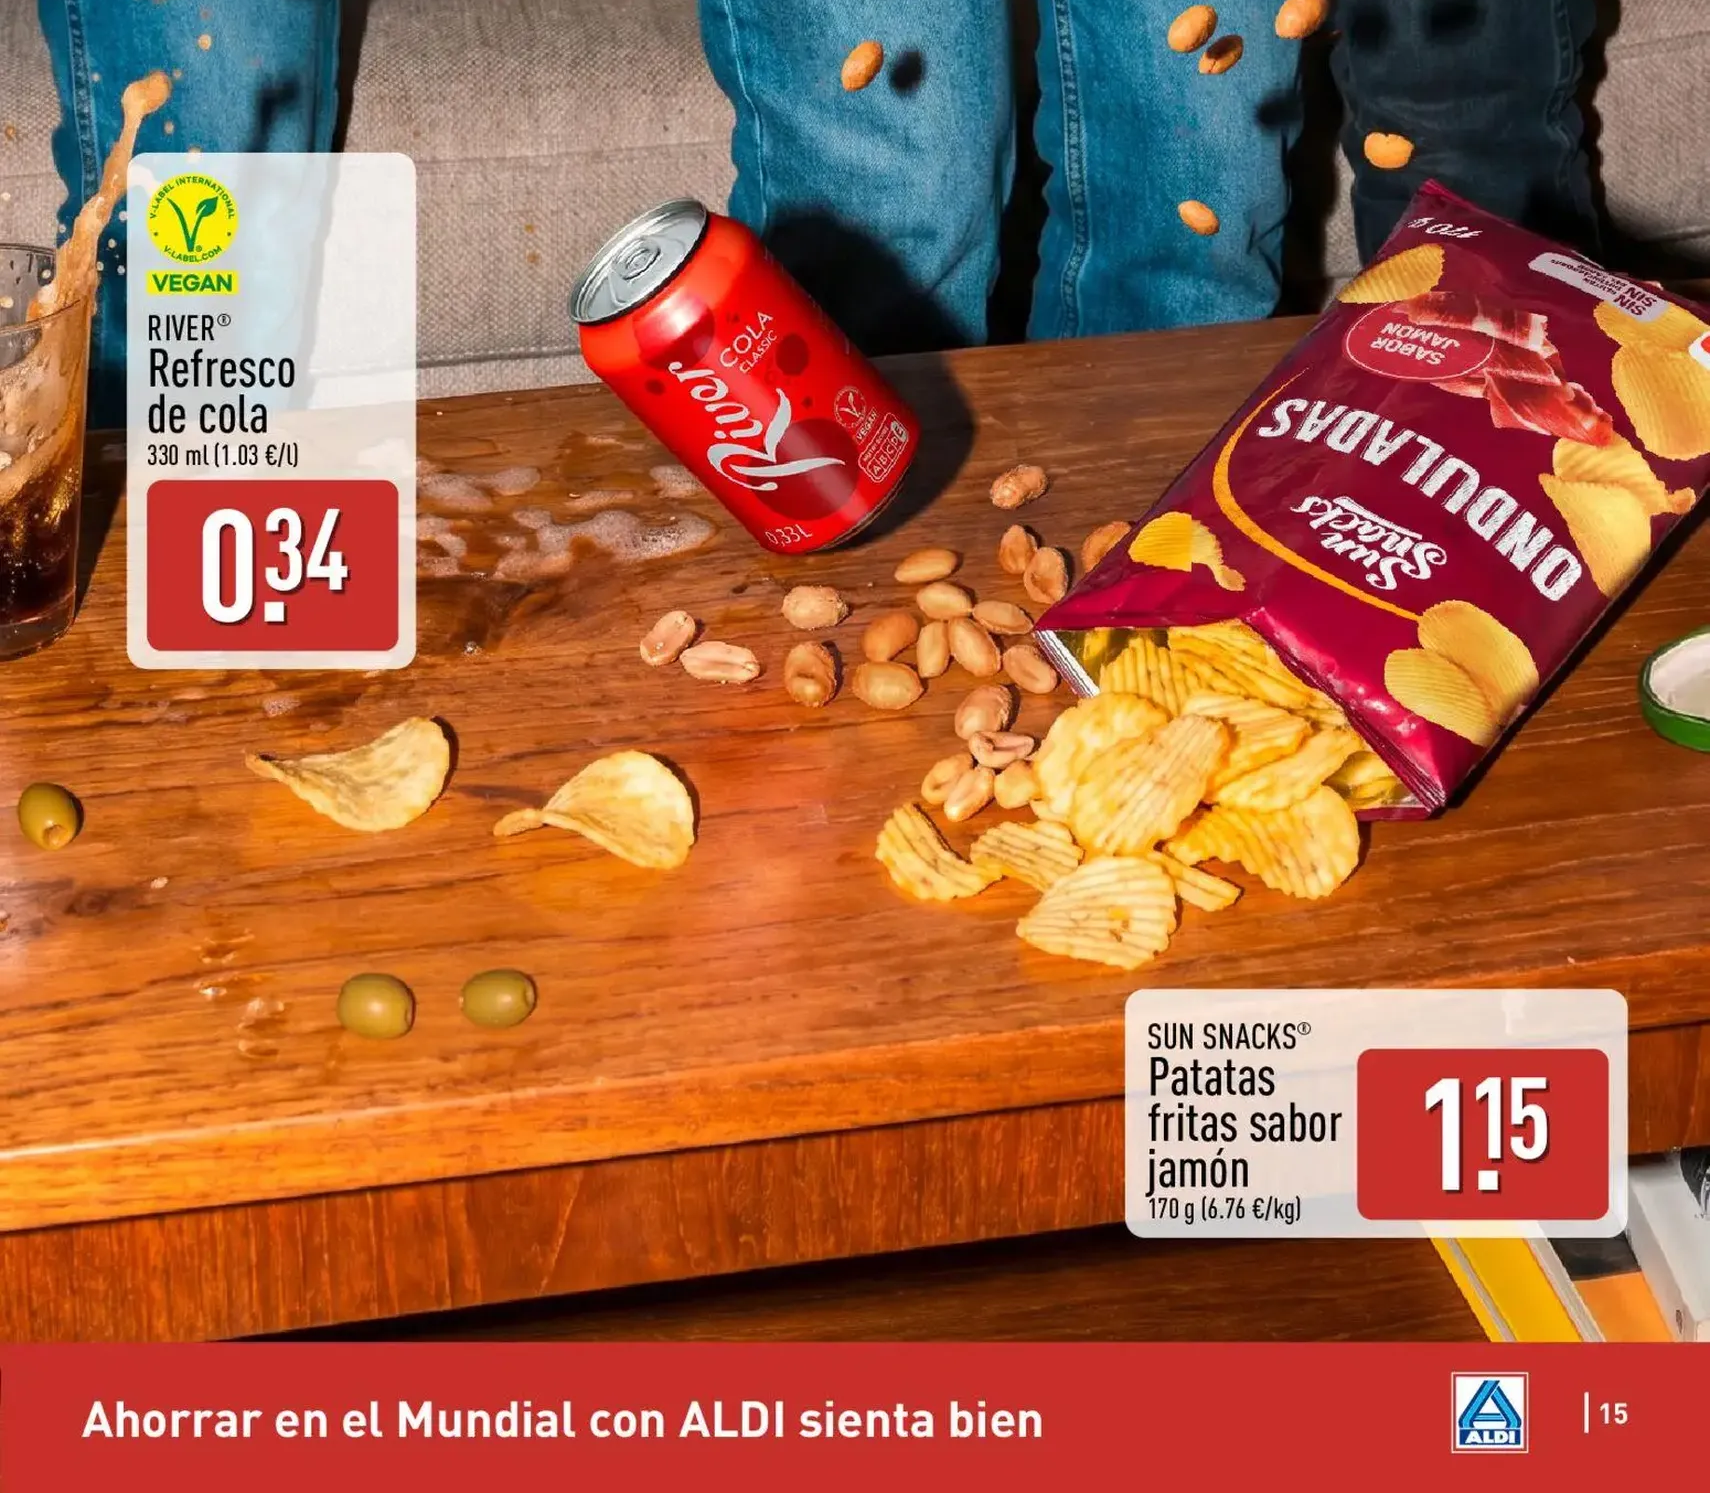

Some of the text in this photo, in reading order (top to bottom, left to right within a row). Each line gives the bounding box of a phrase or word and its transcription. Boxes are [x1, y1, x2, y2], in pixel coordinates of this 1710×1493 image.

[150, 176, 235, 219] V-LABEL INTERNATIONAL
[163, 245, 222, 263] V-LABEL.COM
[152, 274, 232, 292] VEGAN
[1624, 287, 1657, 307] SIN
[1613, 295, 1647, 316] SIN
[719, 311, 773, 369] COLA
[740, 330, 777, 373] CLASSIC
[1370, 336, 1446, 365] SABOR
[150, 349, 294, 388] Refresco
[149, 394, 267, 433] de cola
[668, 361, 846, 492] River
[148, 445, 178, 465] 330
[187, 445, 209, 465] ml
[215, 443, 258, 467] (1.03
[1257, 396, 1585, 603] ONDULADAS
[1290, 496, 1447, 580] Snacks
[1320, 532, 1406, 590] Sun
[1149, 1023, 1193, 1049] SUN
[1151, 1057, 1274, 1096] Patatas
[1148, 1102, 1342, 1142] fritas sabor
[1146, 1148, 1248, 1198] jamón
[1149, 1196, 1300, 1225] 170 g (6.76 €/kg)
